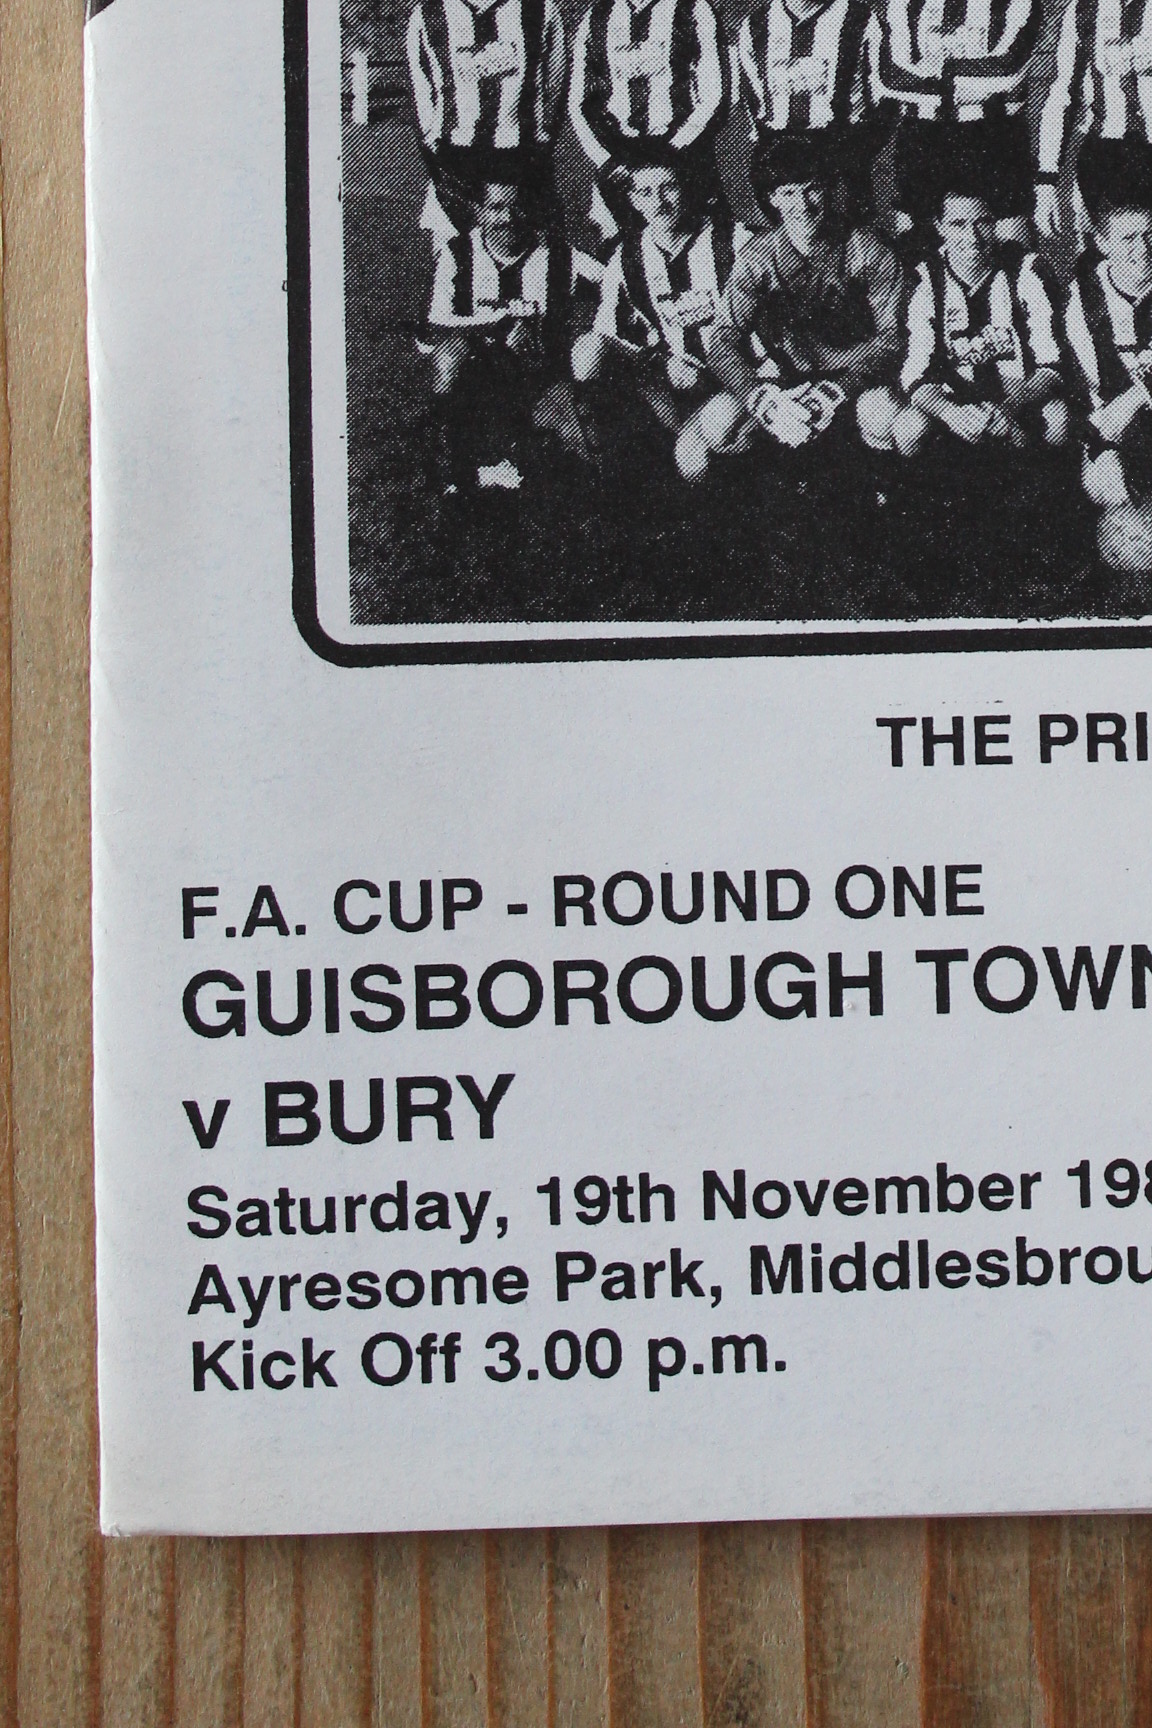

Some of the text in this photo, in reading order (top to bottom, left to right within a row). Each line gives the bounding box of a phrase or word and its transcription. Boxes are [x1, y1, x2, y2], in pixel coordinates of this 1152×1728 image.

[876, 714, 1013, 768] THE
[182, 884, 307, 940] F.A.
[333, 878, 483, 935] CUP
[553, 868, 811, 927] ROUND
[834, 864, 985, 920] ONE
[183, 950, 884, 1039] GUISBOROUGH
[182, 1073, 516, 1150] v BURY
[187, 1180, 508, 1245] Saturday,
[536, 1172, 676, 1226] 19th
[702, 1162, 1042, 1221] November
[187, 1265, 529, 1329] Ayresome
[555, 1247, 722, 1309] Park,
[192, 1328, 787, 1393] Kick Off 3.00 p.m.
